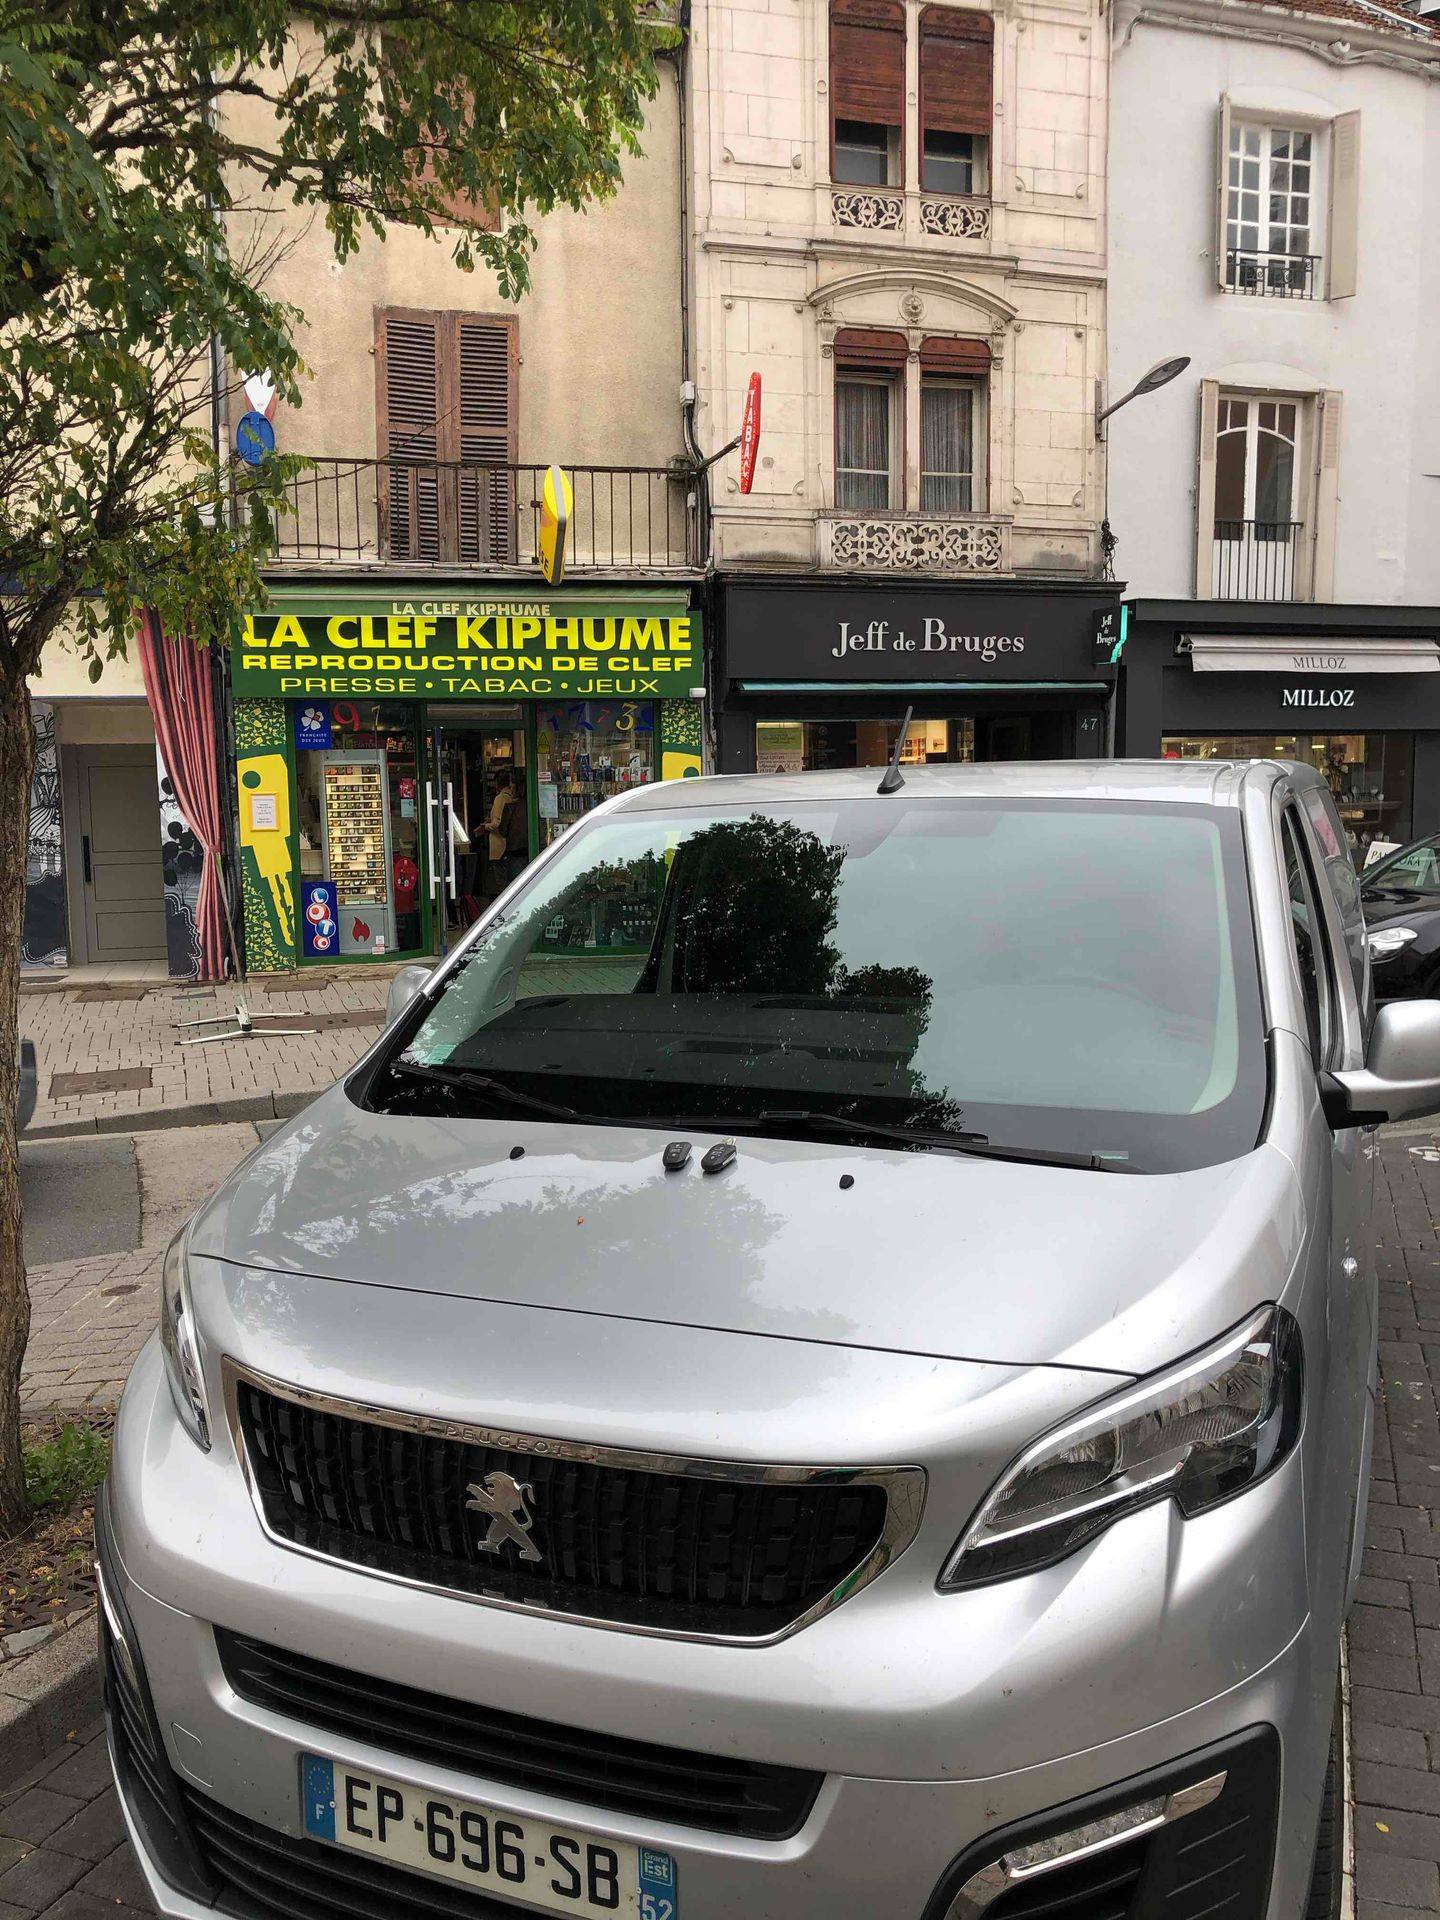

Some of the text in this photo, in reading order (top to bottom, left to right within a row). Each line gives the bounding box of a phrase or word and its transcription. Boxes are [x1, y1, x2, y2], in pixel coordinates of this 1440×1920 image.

[742, 389, 755, 478] TABAC
[392, 602, 551, 617] LA CLEF KIPHUME
[1100, 614, 1113, 628] Jeff
[242, 615, 692, 651] LA CLEF KIPHUME
[831, 617, 1026, 663] Jeff de Bruges
[1096, 632, 1117, 646] Bruges
[242, 654, 693, 673] REPRODUCTION DE CLEF
[1292, 656, 1347, 669] MILLOZ
[280, 677, 660, 694] PRESSE TABAC JEUX
[1281, 689, 1355, 707] MILLOZ
[1081, 718, 1098, 731] 47
[444, 1423, 567, 1457] PEUGEOT
[315, 1775, 620, 1910] F EP-696-SB
[644, 1852, 669, 1865] Grand
[644, 1859, 669, 1879] Est
[641, 1893, 673, 1920] 52
